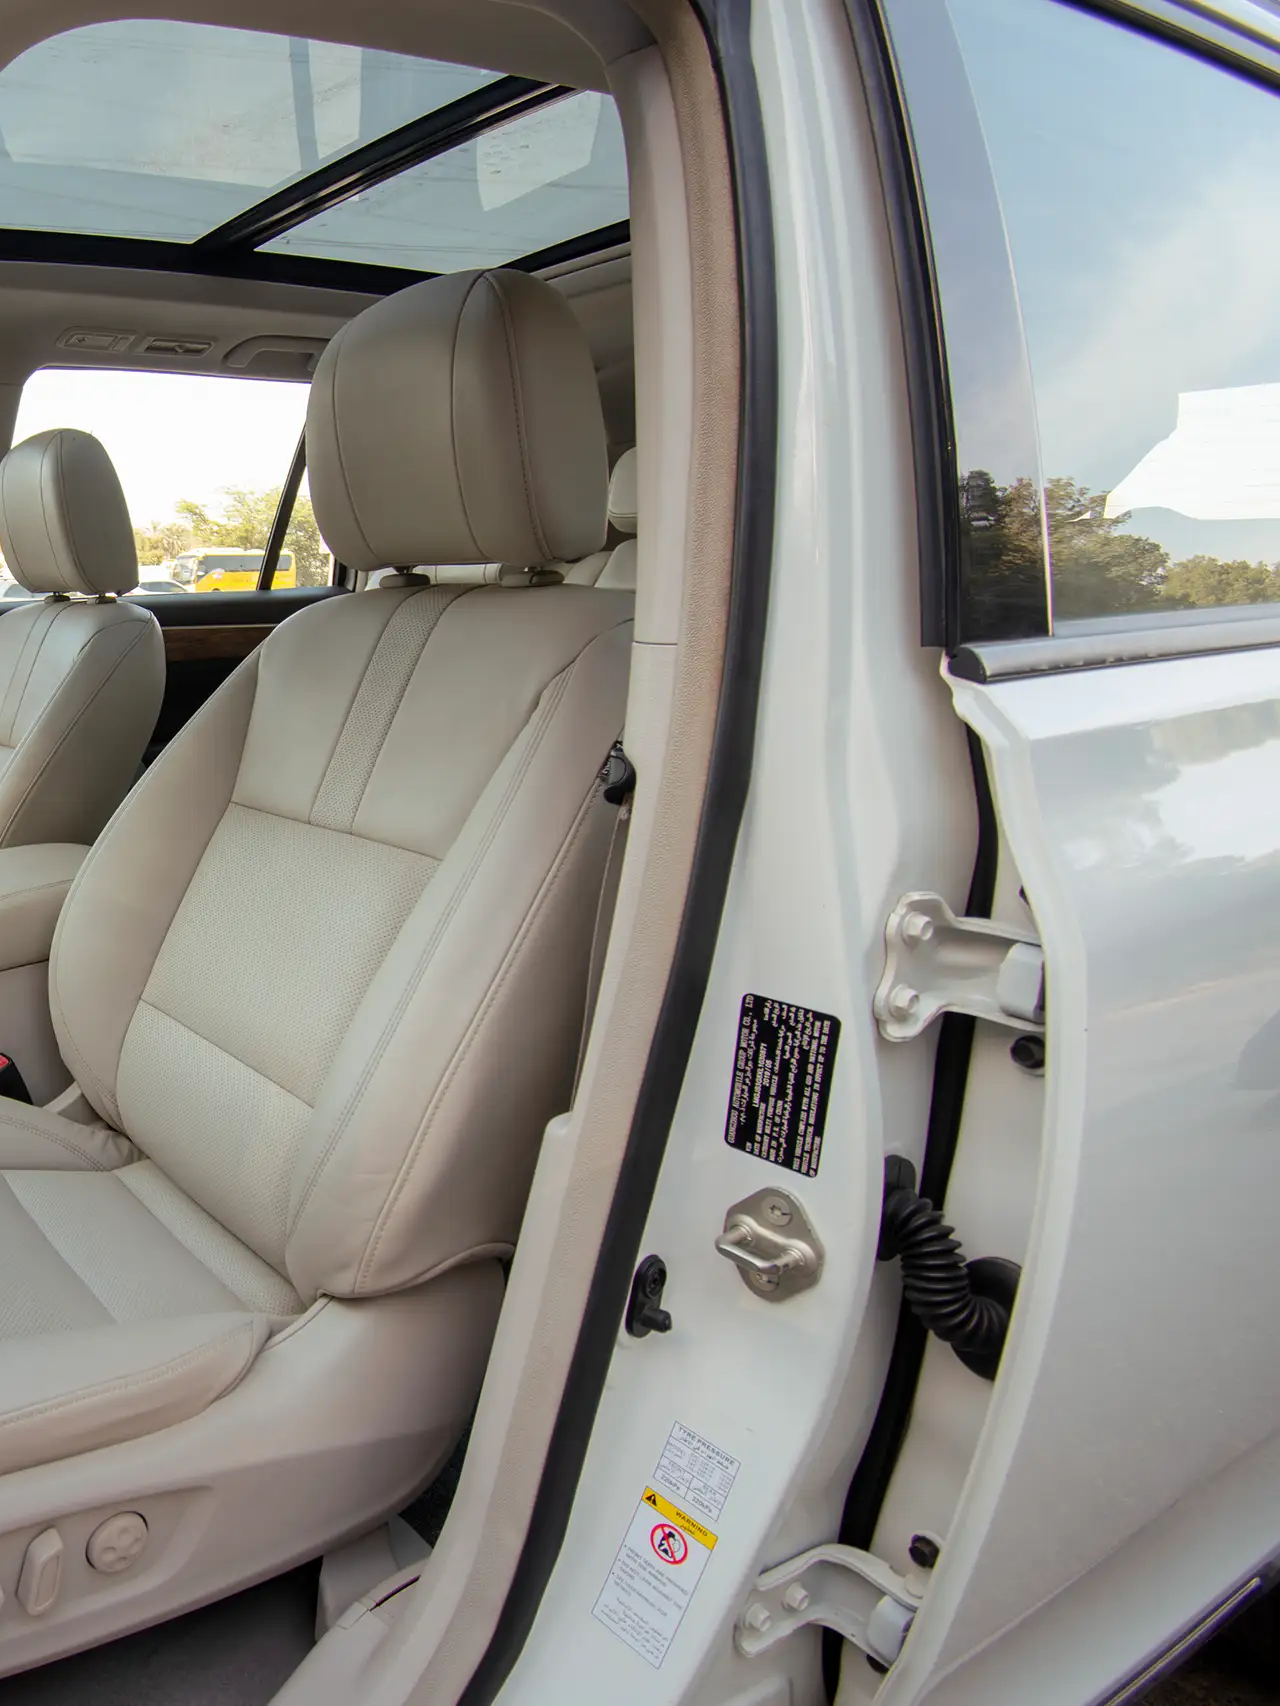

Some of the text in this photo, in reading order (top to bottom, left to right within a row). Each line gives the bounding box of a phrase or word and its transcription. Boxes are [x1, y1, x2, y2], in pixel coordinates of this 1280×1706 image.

[745, 994, 753, 1008] LTD
[740, 1027, 749, 1048] MOTOR
[737, 1048, 746, 1069] GROUP
[762, 1059, 772, 1087] 2019/05
[732, 1070, 743, 1108] AUTOMOBILE
[678, 1426, 696, 1441] TYRE
[696, 1438, 734, 1466] PRESSURE
[675, 1510, 708, 1537] WARNING
